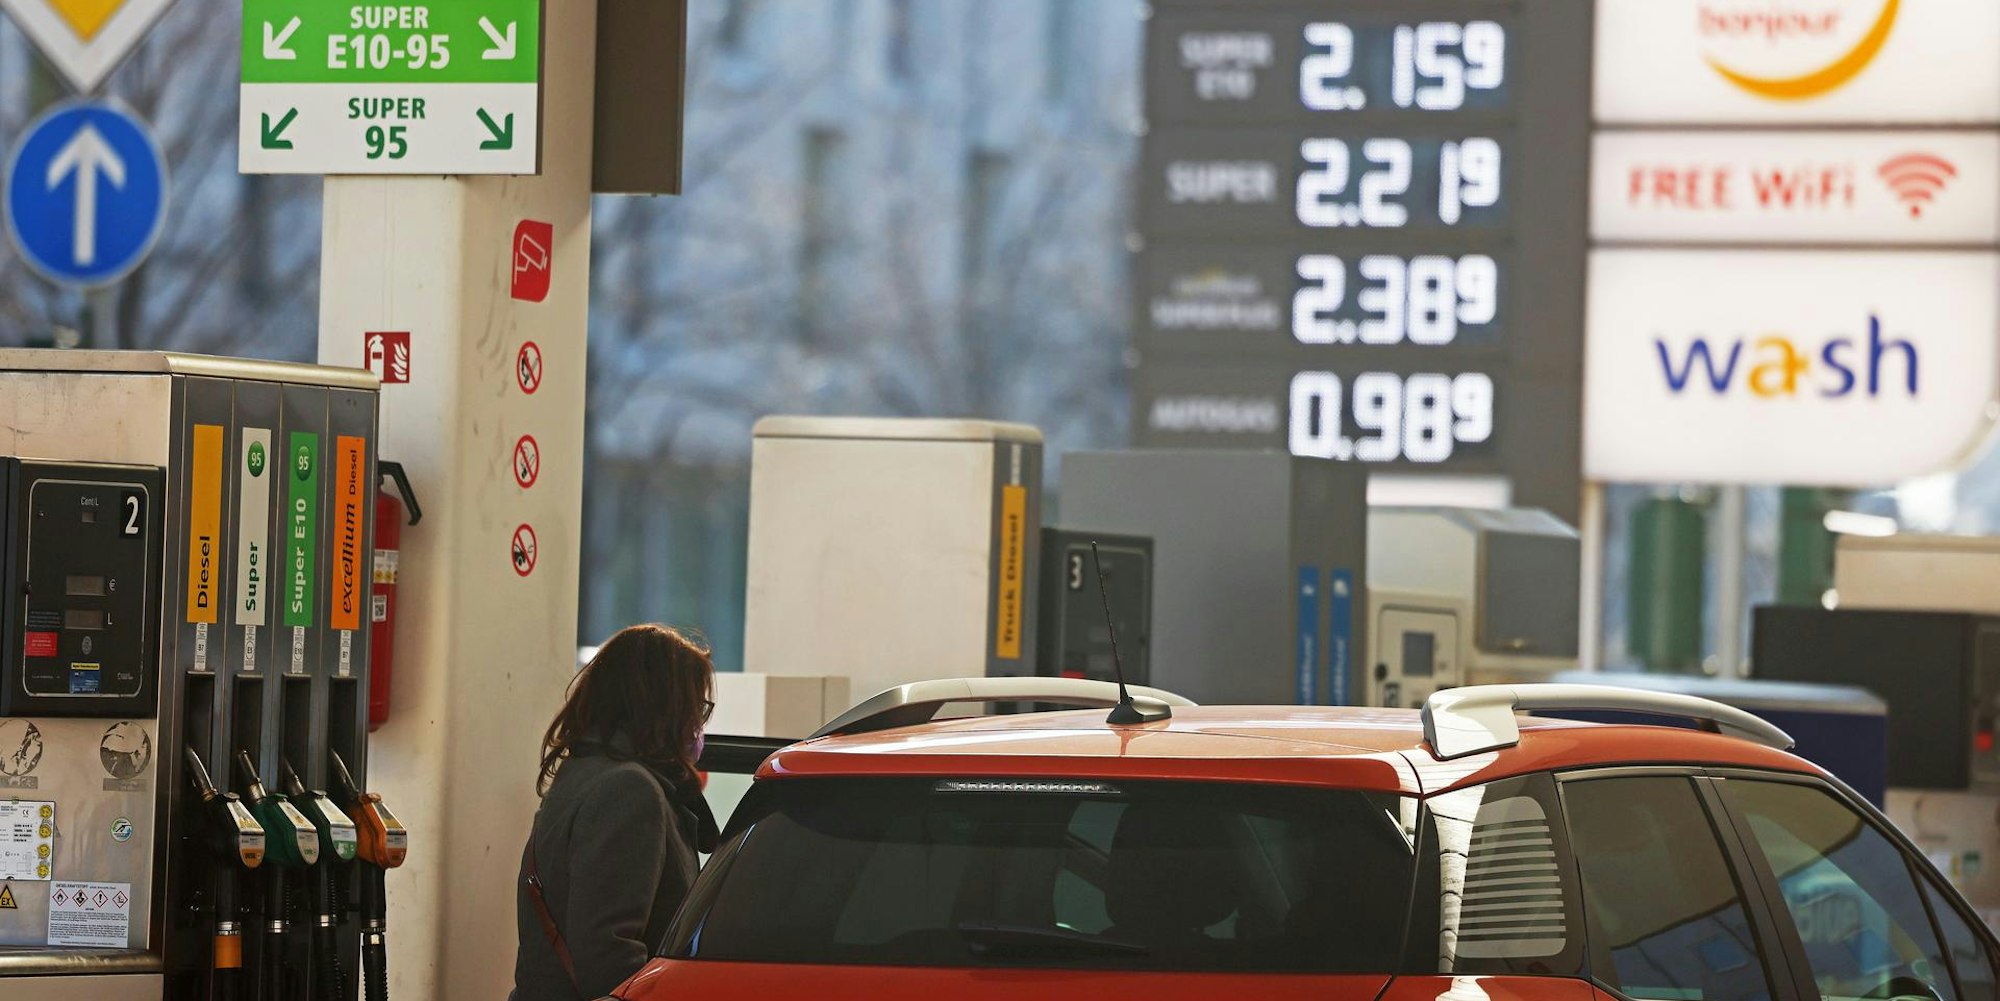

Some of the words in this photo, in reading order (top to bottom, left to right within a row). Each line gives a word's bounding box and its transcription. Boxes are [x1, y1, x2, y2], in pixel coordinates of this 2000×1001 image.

[350, 6, 429, 29] SUPER
[327, 33, 450, 69] E10-95
[1180, 31, 1273, 67] SUPER
[1301, 21, 1505, 110] 2.159
[348, 97, 426, 119] SUPER
[365, 125, 408, 160] 95
[1167, 160, 1276, 203] SUPER
[1297, 137, 1500, 227] 2.219
[1629, 167, 1732, 208] FREE
[1292, 254, 1497, 344] 2.389
[1655, 313, 1918, 398] wash
[1289, 371, 1494, 462] 0.989
[251, 452, 262, 467] 95
[298, 456, 309, 471] 95
[125, 496, 139, 534] 2
[295, 498, 307, 539] E10
[342, 503, 355, 614] excellium
[349, 449, 357, 495] Diesel
[1007, 514, 1019, 581] Diesel
[197, 535, 211, 608] Diesel
[245, 541, 260, 611] Super
[291, 547, 307, 613] Super
[1070, 555, 1083, 590] 3
[107, 612, 113, 625] L
[1004, 589, 1016, 643] Truck
